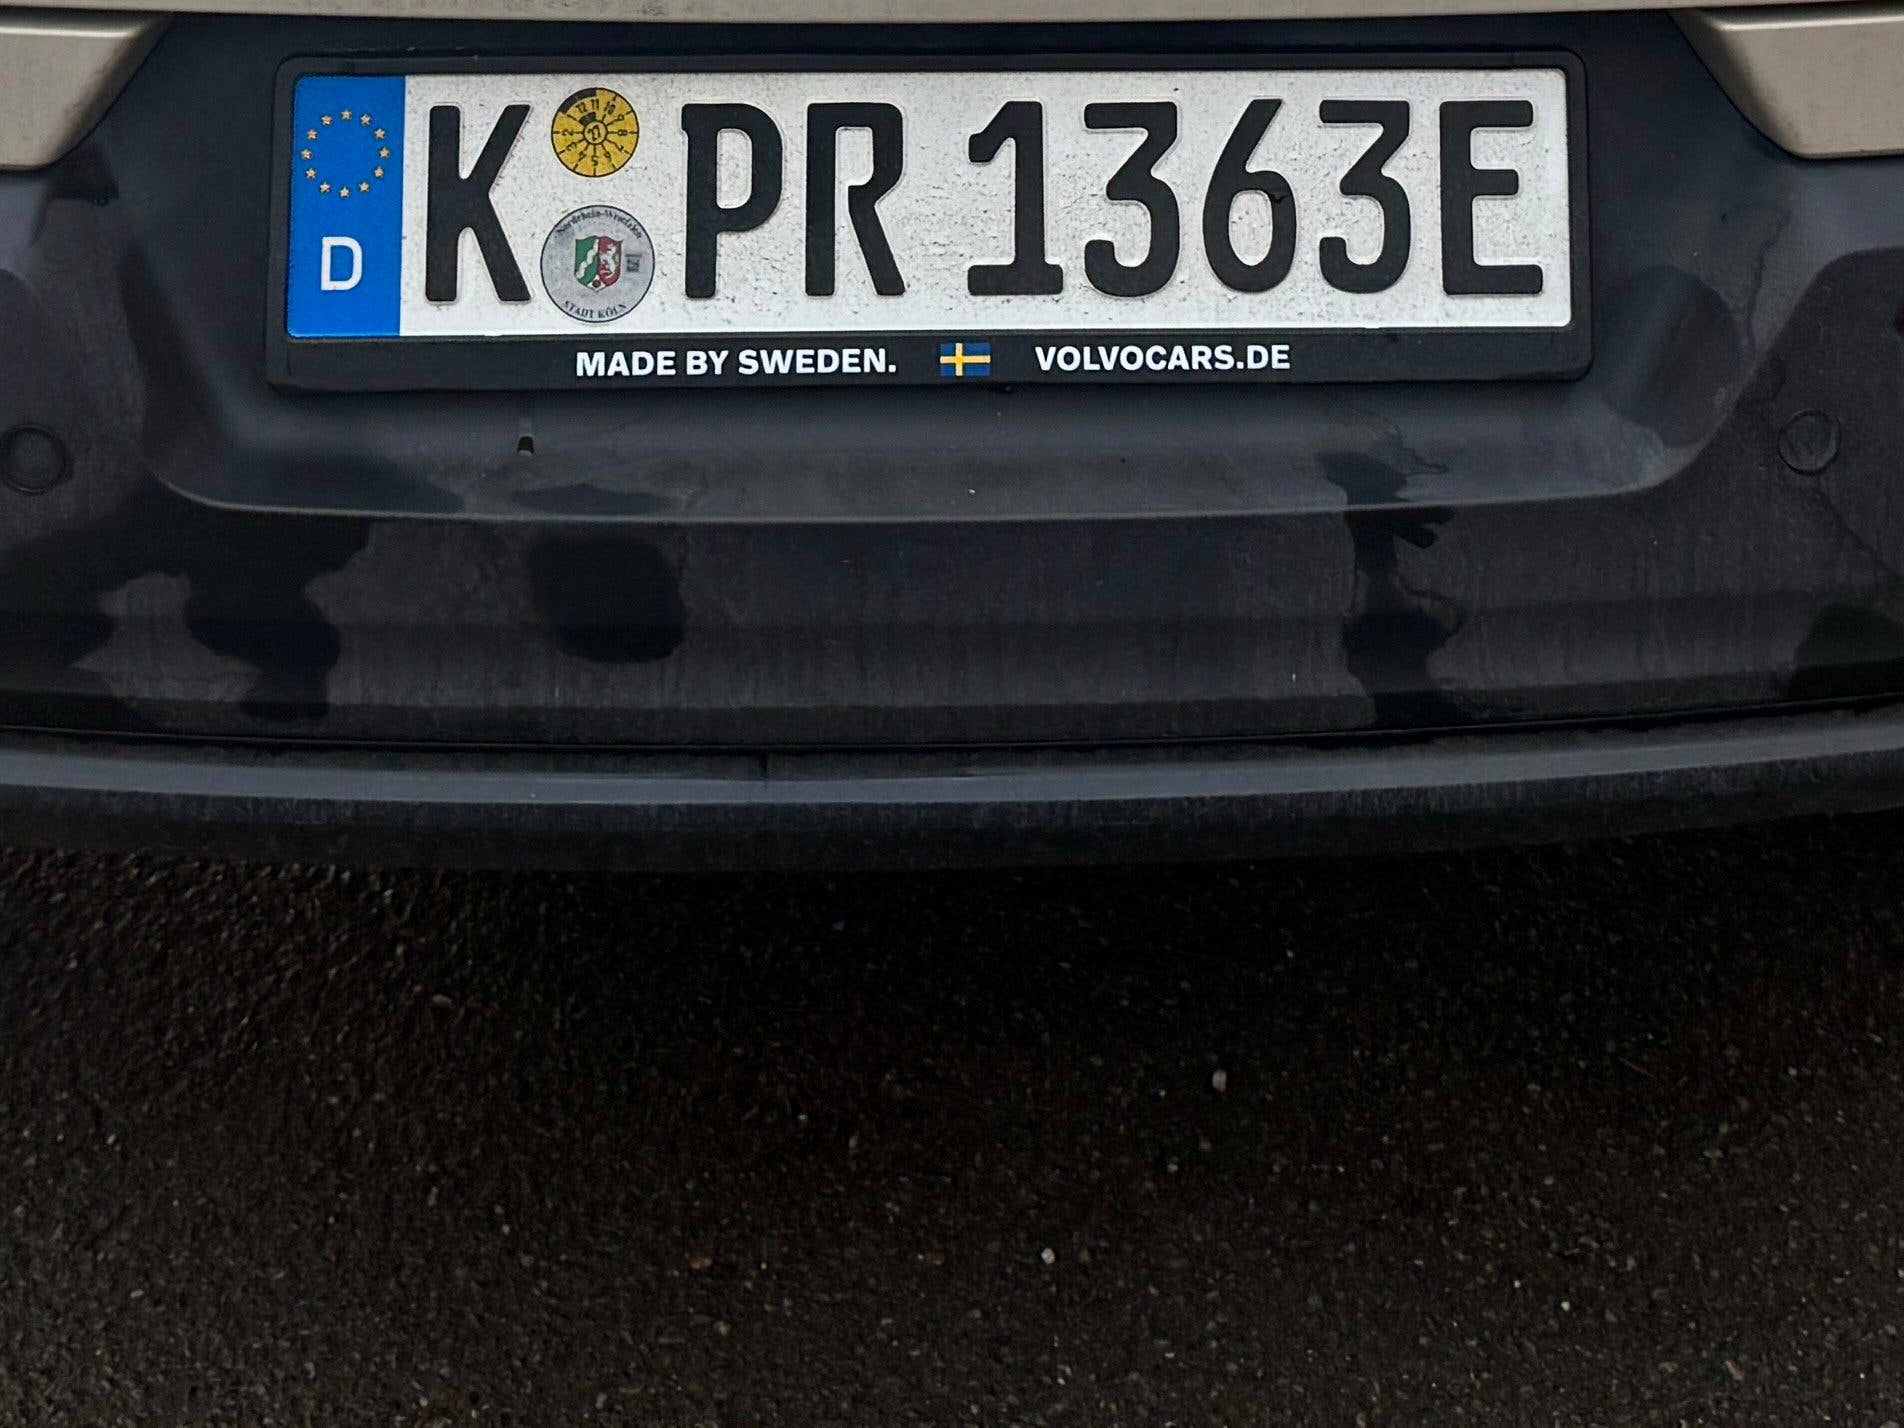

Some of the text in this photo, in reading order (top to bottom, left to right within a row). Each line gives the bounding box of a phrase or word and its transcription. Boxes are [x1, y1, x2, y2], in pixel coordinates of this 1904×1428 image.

[423, 97, 1545, 304] K PR 1363E
[321, 236, 363, 291] D
[563, 300, 627, 319] STADT KÖLN
[576, 347, 897, 377] MADE BY SWEDEN.
[1034, 344, 1291, 372] VOLVOCARS.DE
